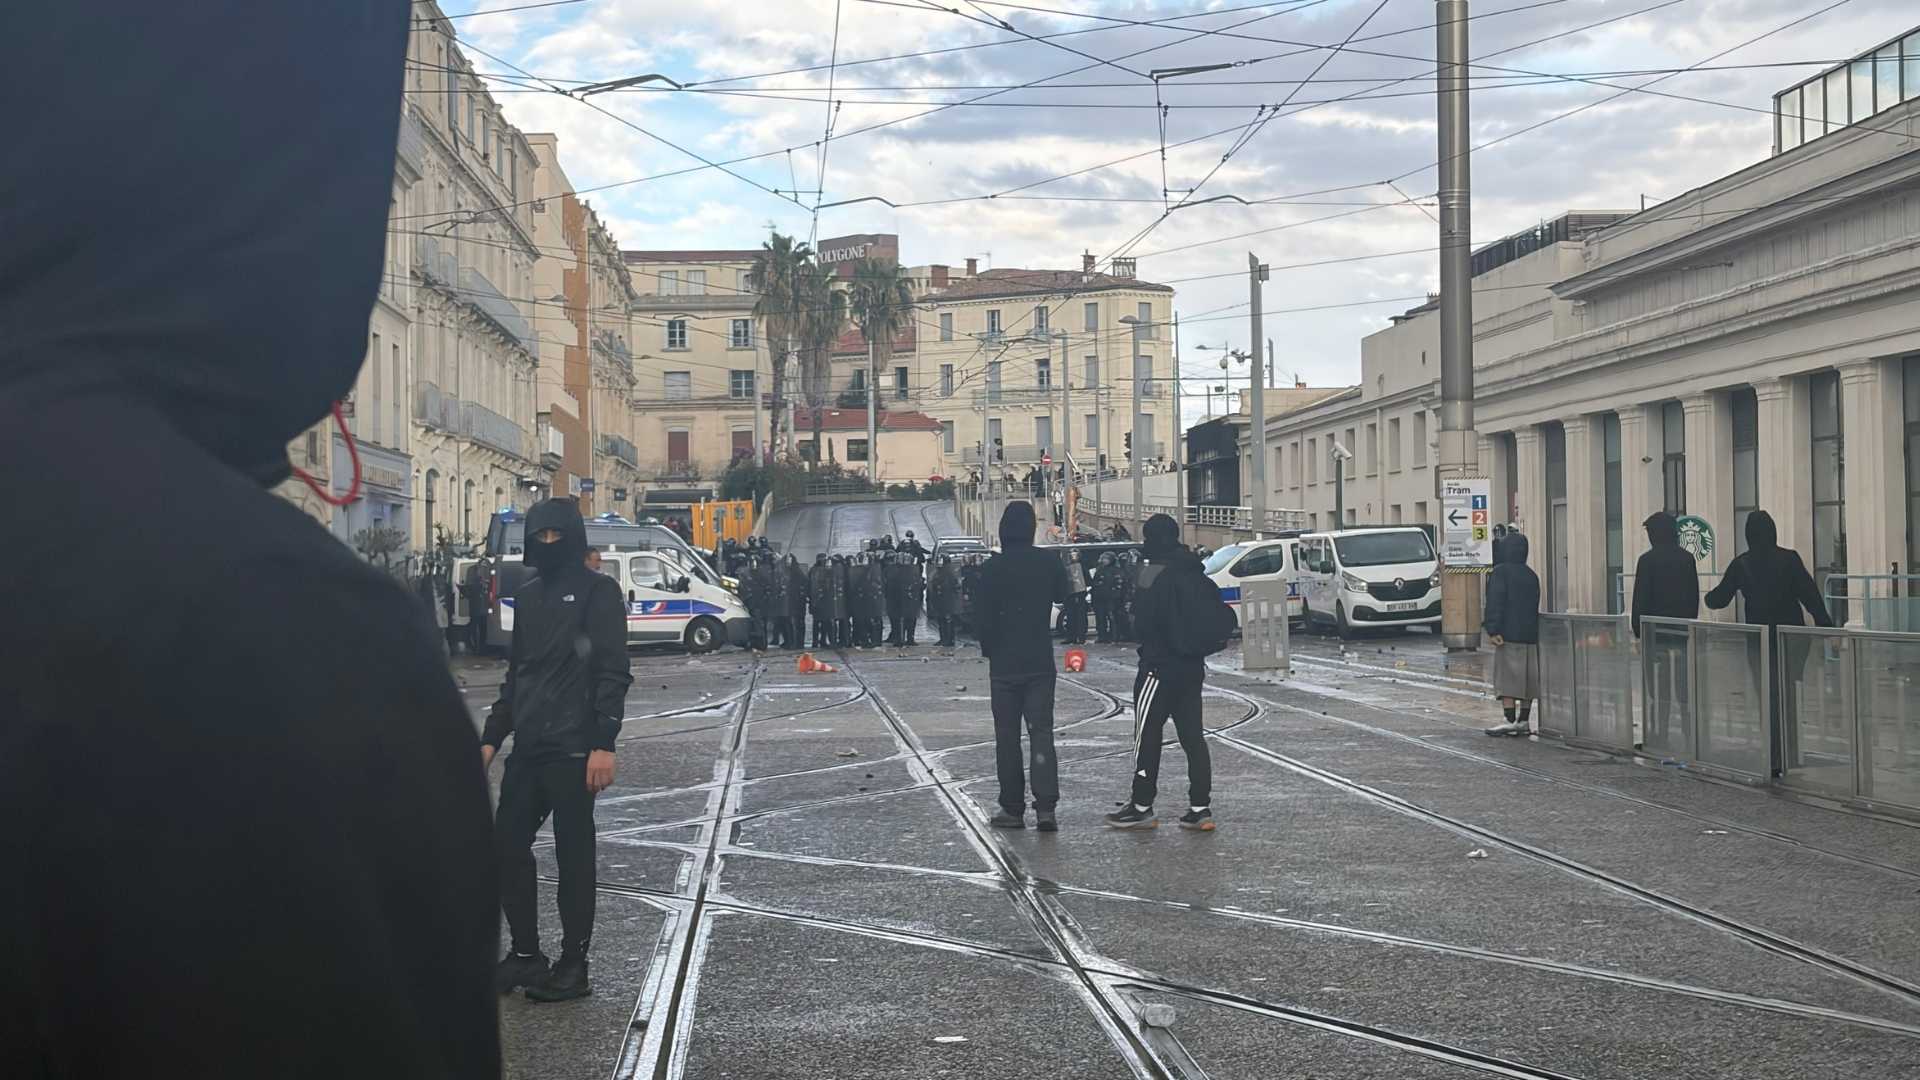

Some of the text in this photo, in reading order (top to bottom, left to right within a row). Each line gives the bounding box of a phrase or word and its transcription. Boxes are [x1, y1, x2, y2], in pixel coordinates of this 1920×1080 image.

[1476, 496, 1482, 508] 1
[1476, 512, 1484, 524] 2
[1476, 528, 1484, 540] 3
